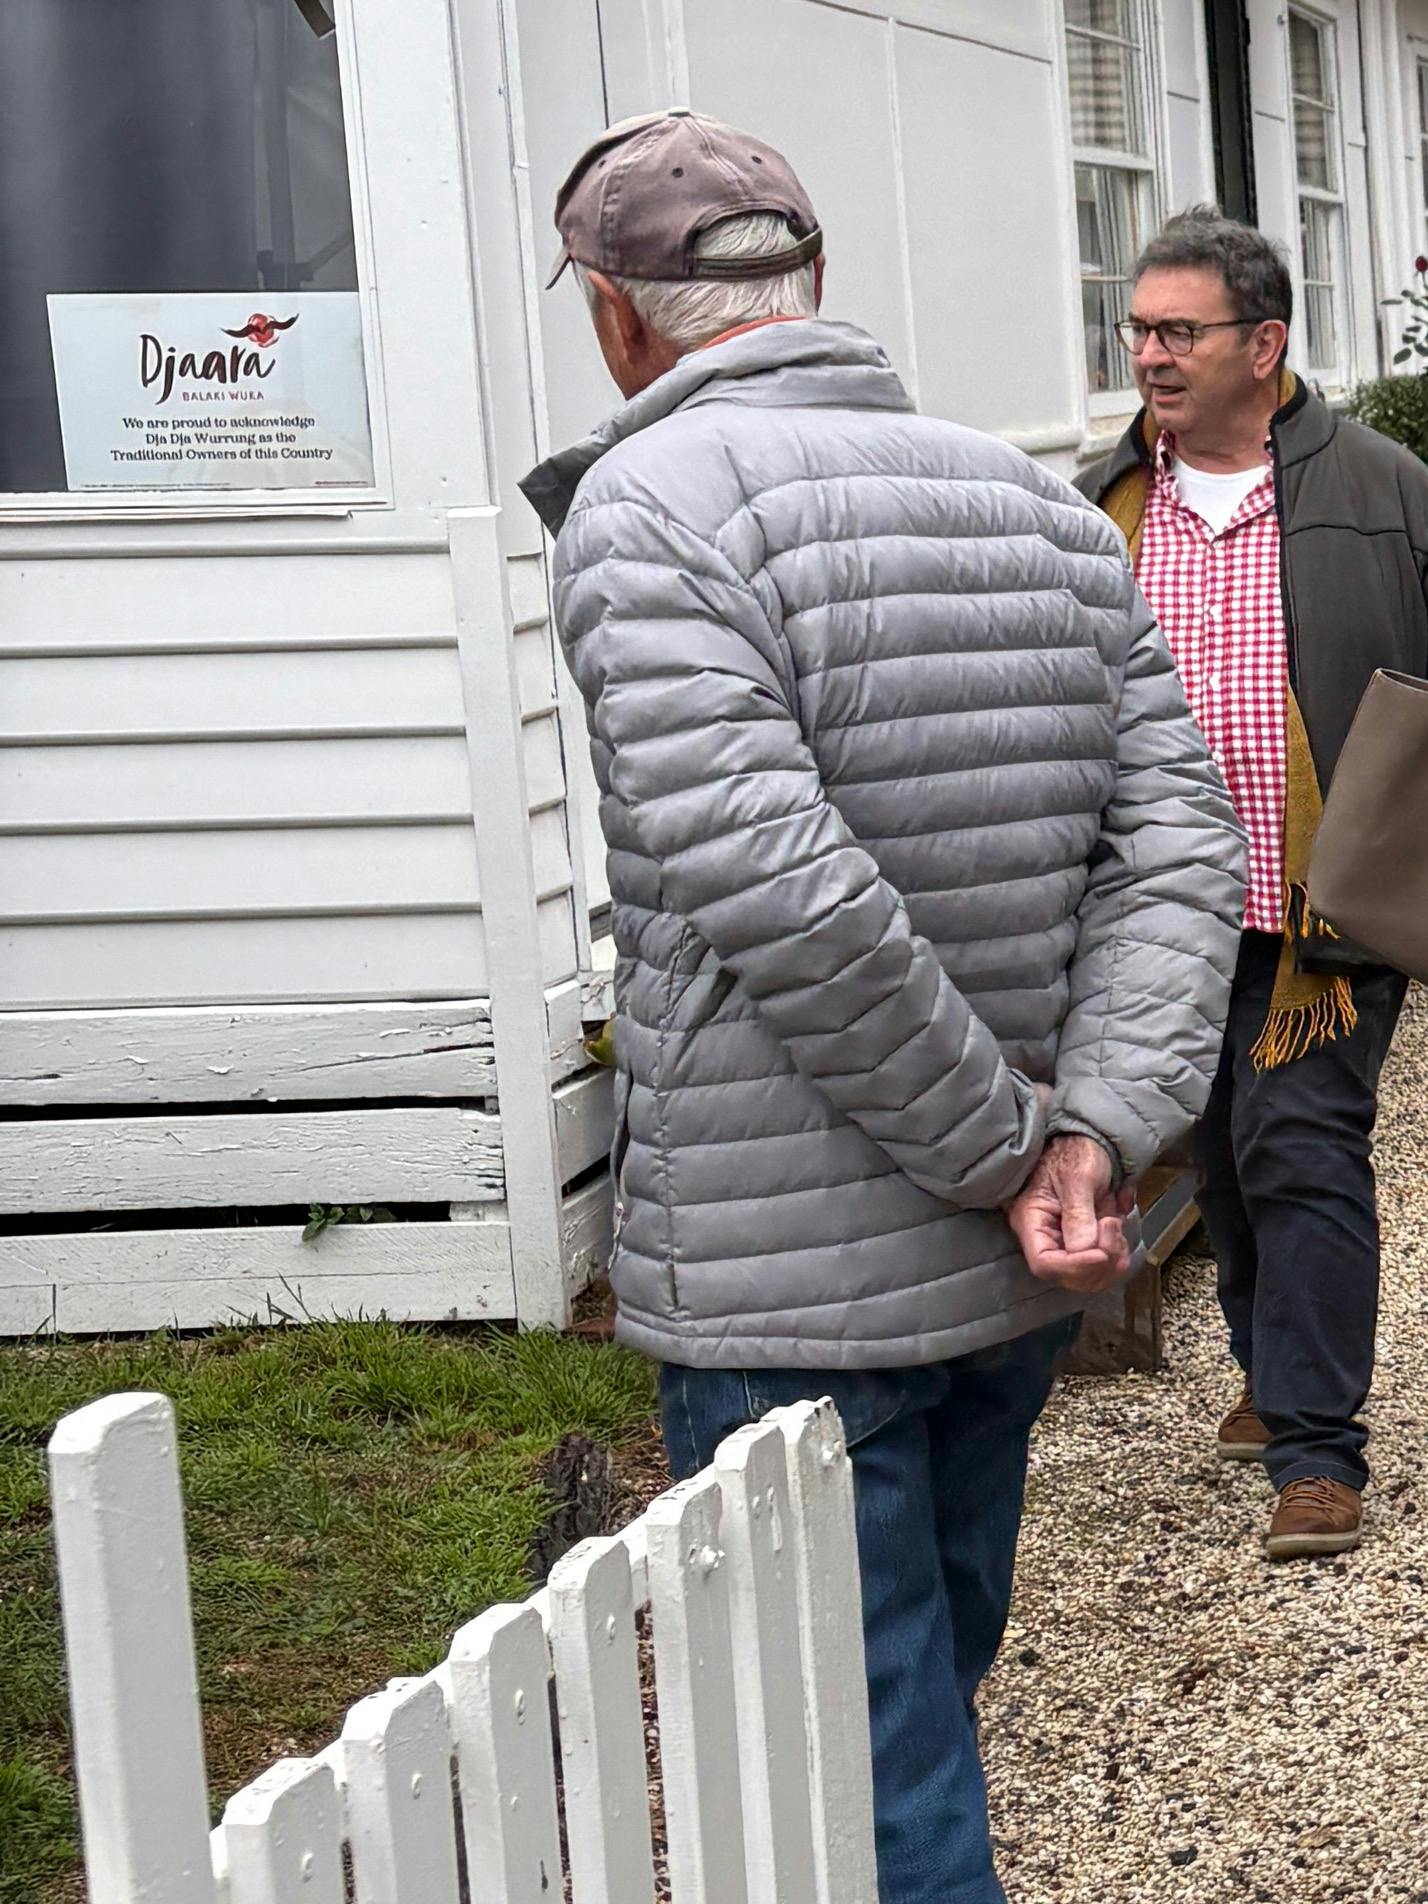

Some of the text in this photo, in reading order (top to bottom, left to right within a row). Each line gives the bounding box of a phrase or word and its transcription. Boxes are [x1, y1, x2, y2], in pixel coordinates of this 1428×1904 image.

[139, 334, 275, 405] Djaara
[182, 391, 225, 401] BALAKI
[123, 415, 315, 431] We are proud to acknowledge
[145, 432, 296, 446] Dja Dja Wurrung as the
[110, 448, 334, 461] Traditional Owners of this Country
